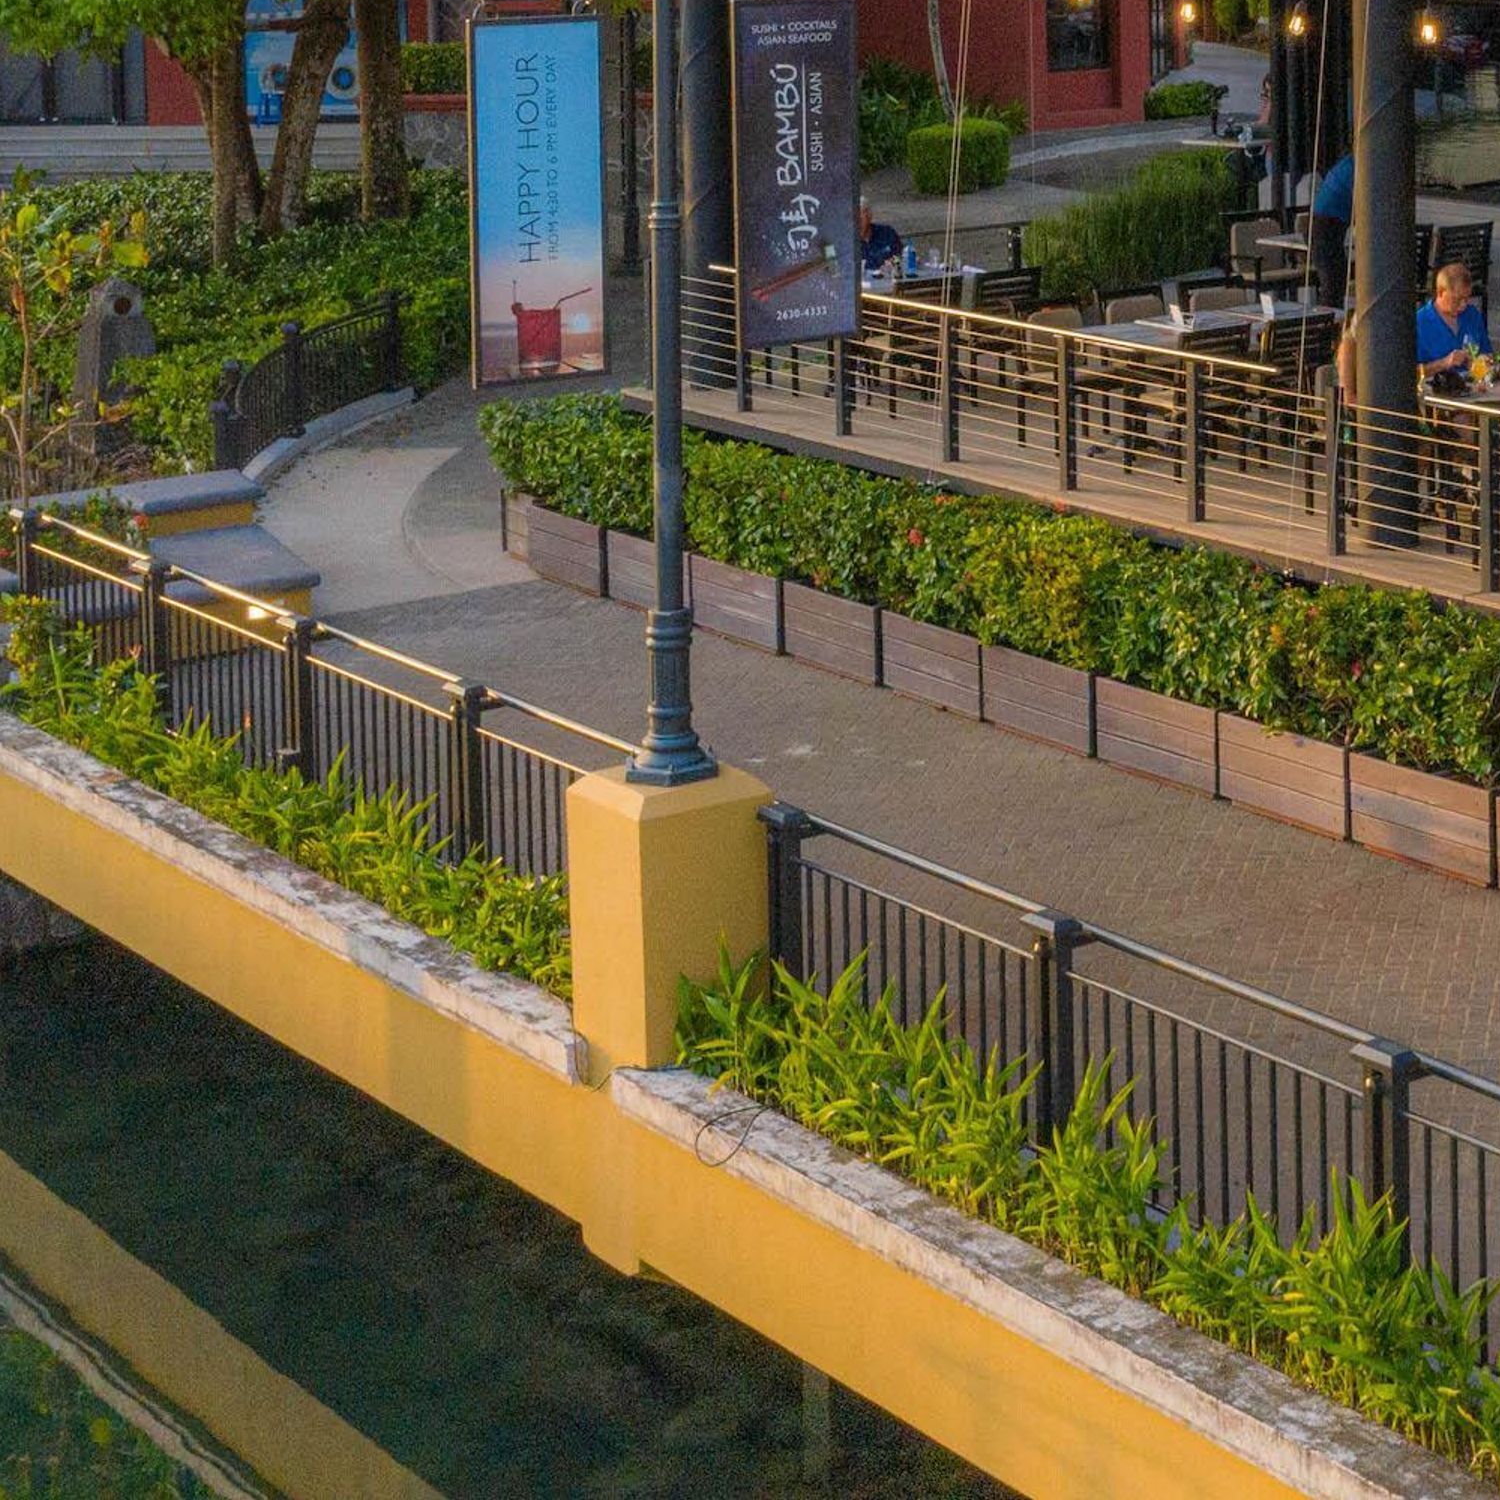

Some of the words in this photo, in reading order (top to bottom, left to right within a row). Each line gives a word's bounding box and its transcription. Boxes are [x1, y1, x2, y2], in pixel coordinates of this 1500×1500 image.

[752, 24, 778, 34] SUSHI
[787, 20, 838, 32] COCKTAILS
[757, 35, 787, 46] ASIAN
[787, 32, 832, 44] SEAFOOD
[545, 55, 557, 82] DAY
[515, 52, 540, 150] HOUR
[545, 88, 557, 127] EVERY
[809, 72, 822, 114] ASIAN
[546, 133, 558, 152] PM
[770, 63, 802, 186] BAMBÚ
[810, 131, 823, 171] SUSHI
[547, 168, 558, 188] TO
[518, 163, 541, 263] HAPPY
[548, 221, 559, 262] FROM
